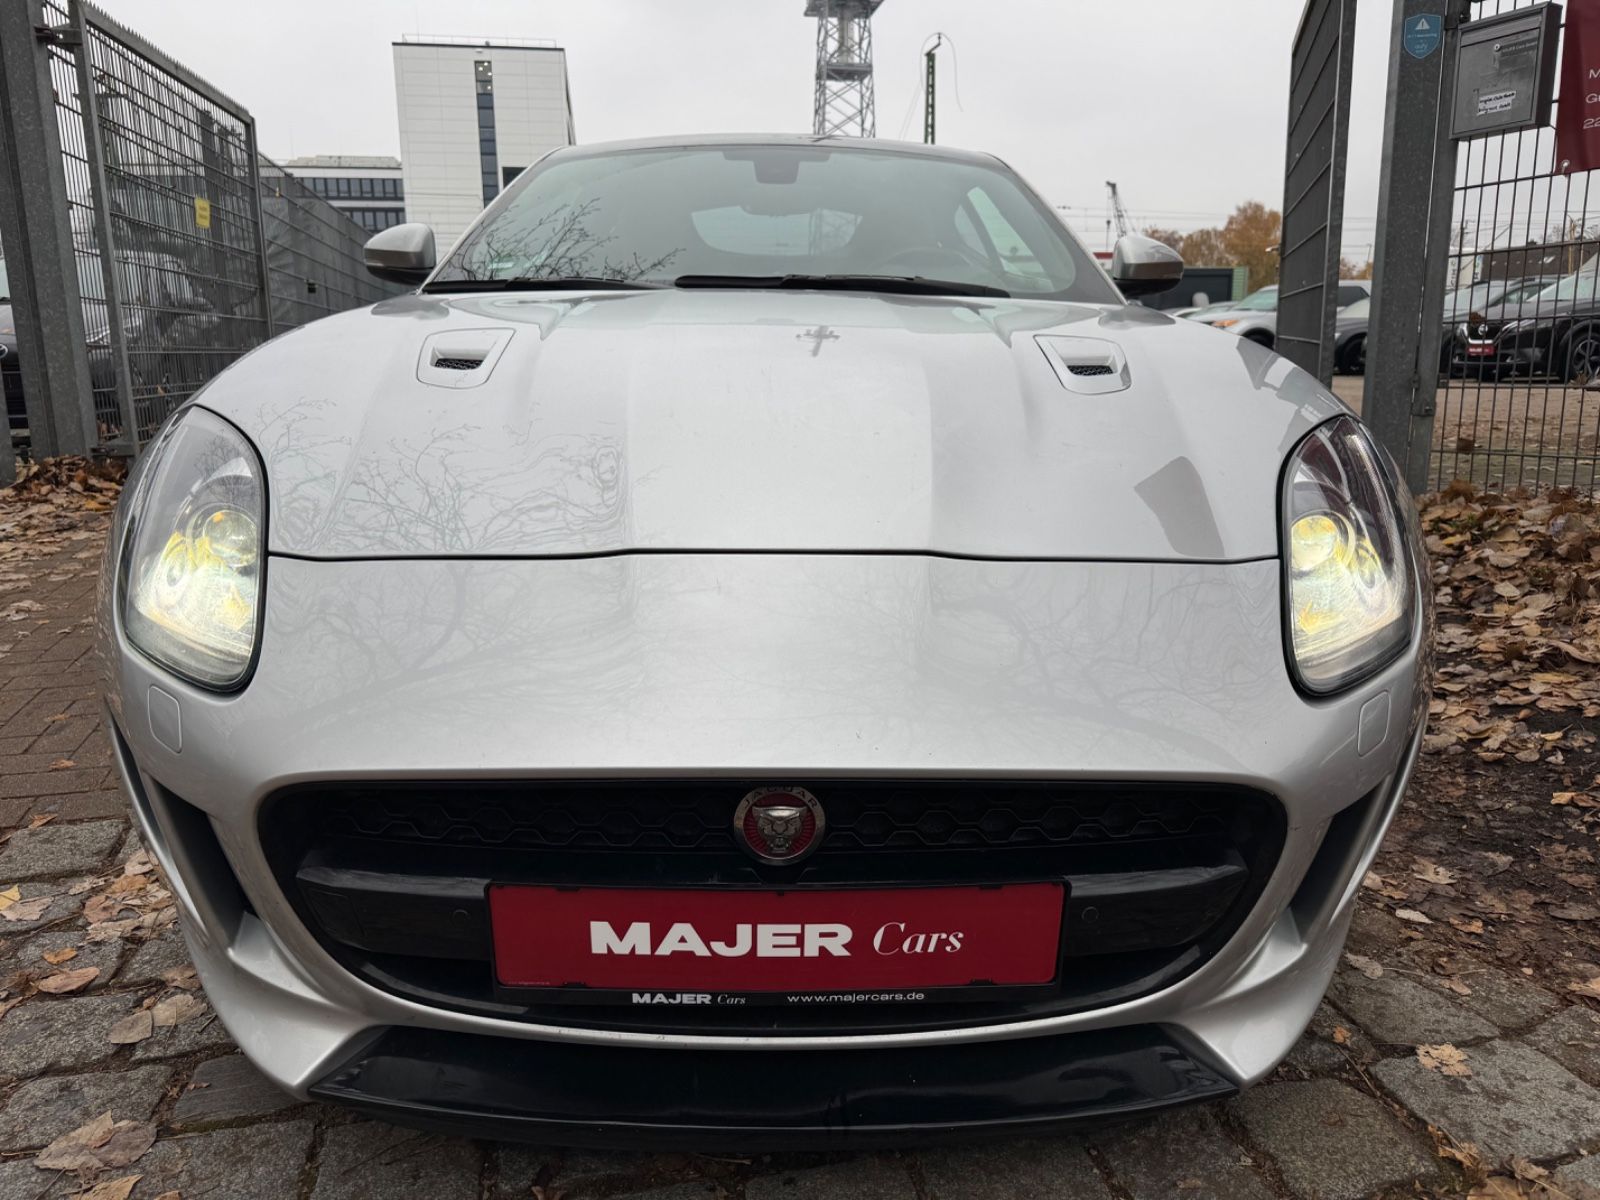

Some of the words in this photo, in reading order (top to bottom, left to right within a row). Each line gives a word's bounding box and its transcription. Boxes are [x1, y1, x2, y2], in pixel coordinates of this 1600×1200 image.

[590, 921, 853, 957] MAJER
[873, 921, 964, 956] Cars
[632, 993, 712, 1005] MAJER
[717, 993, 746, 1005] Cars
[787, 992, 925, 1003] www.majercars.de
